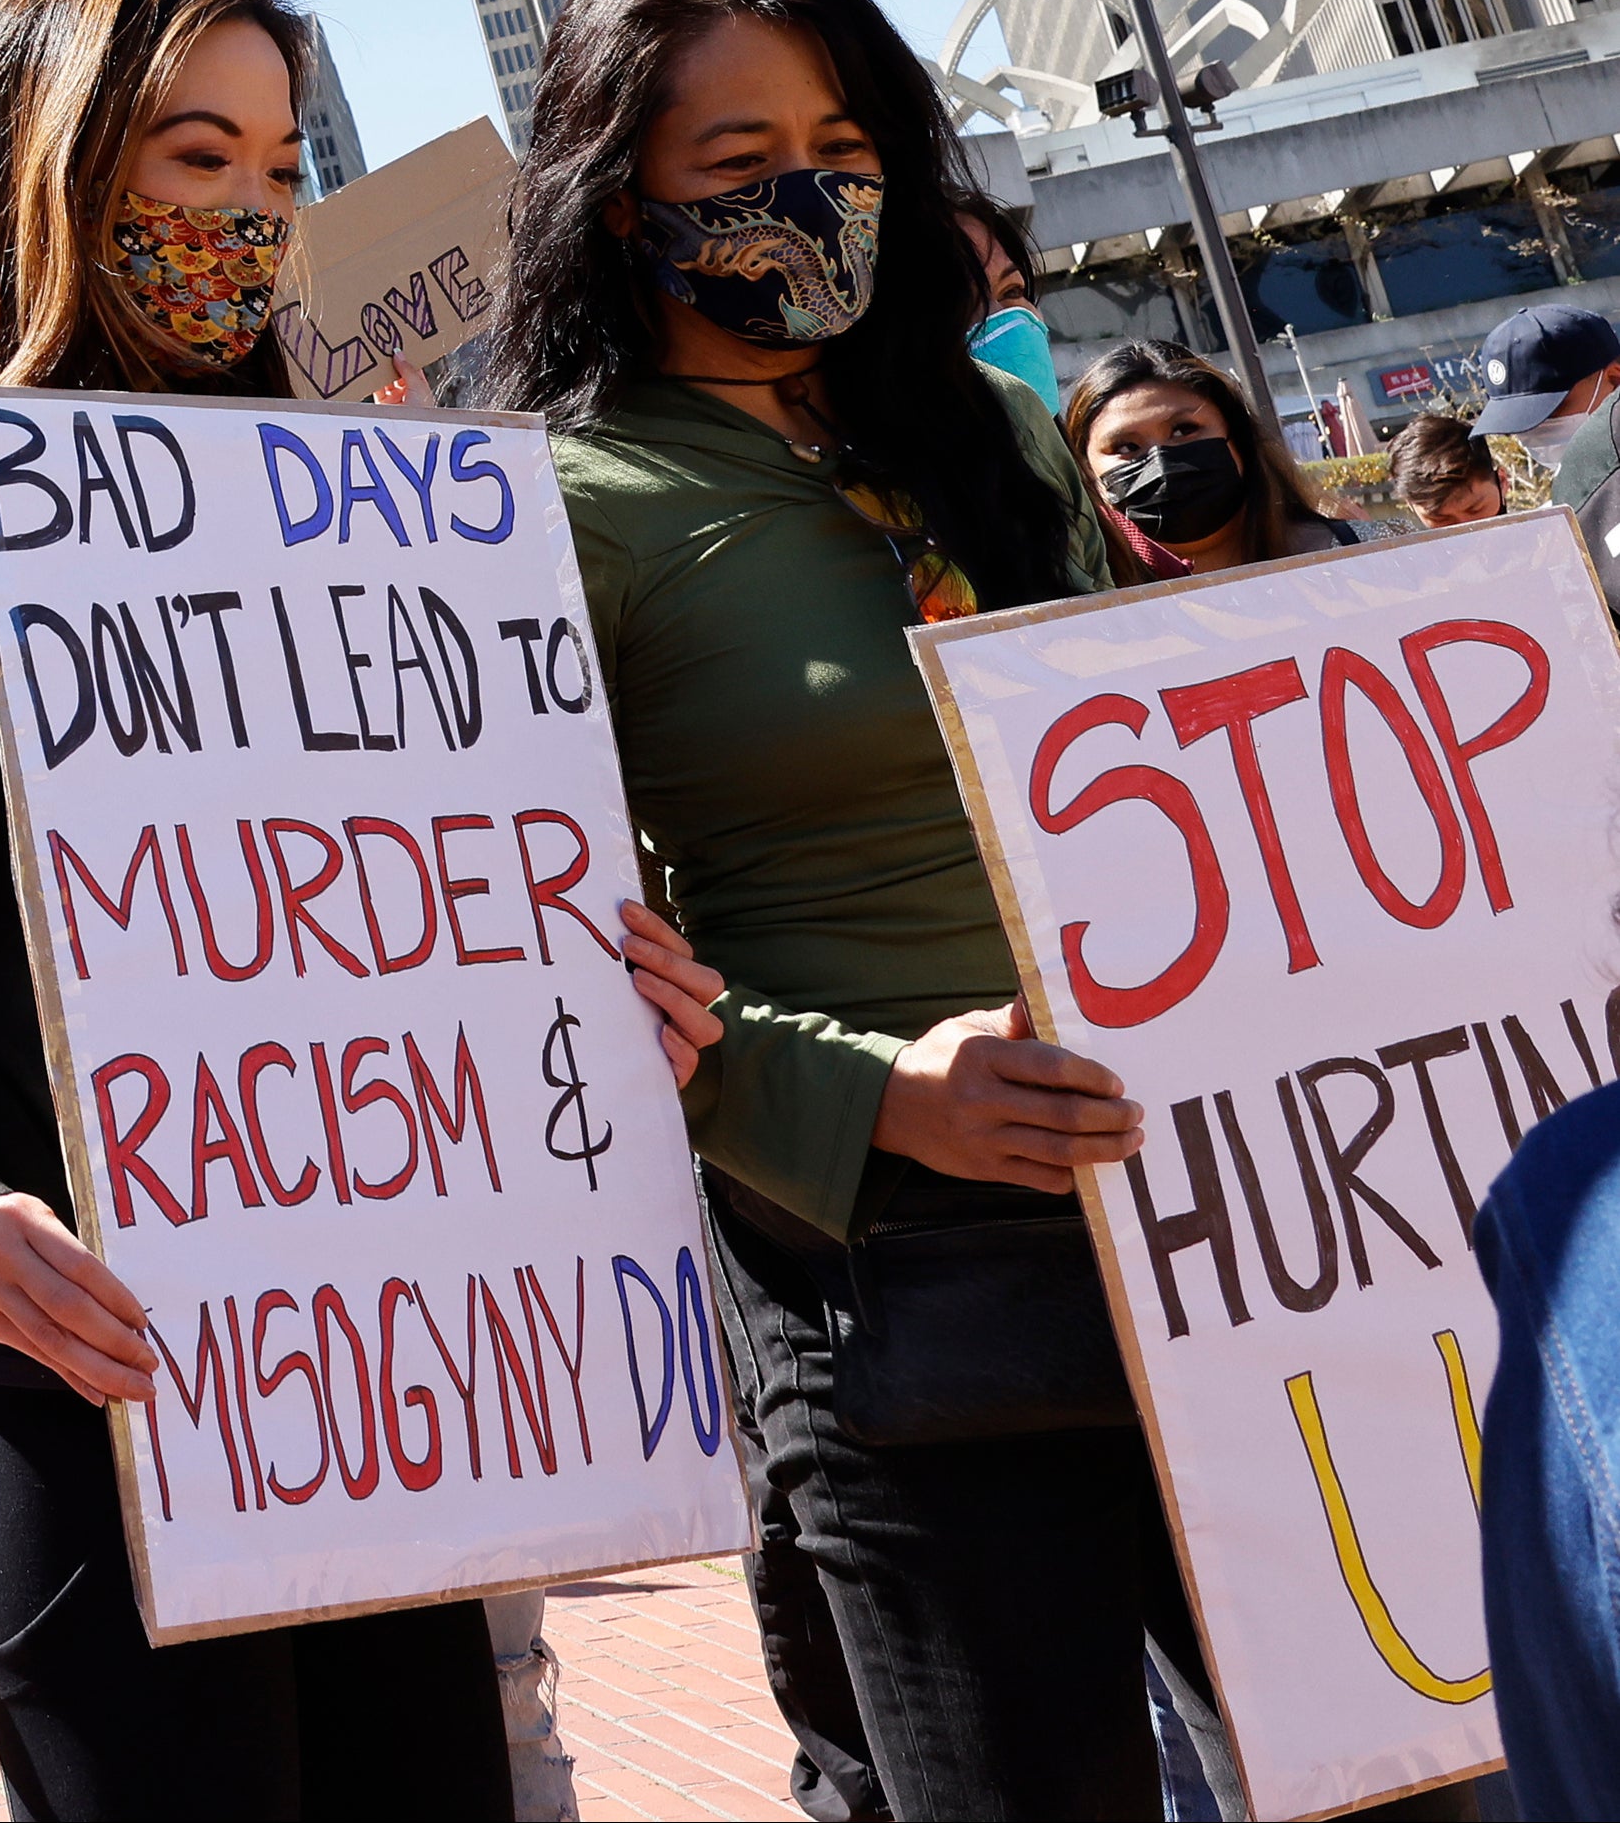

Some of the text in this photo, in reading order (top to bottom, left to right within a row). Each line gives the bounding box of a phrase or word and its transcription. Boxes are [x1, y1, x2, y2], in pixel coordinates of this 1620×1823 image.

[272, 245, 494, 400] LOVE
[1434, 355, 1481, 380] HA
[257, 422, 515, 547] DAYS
[9, 584, 592, 770] DON'T LEAD TO
[46, 808, 622, 982] MURDER
[1029, 619, 1551, 1029] STOP
[91, 996, 613, 1228] RACISM &
[1124, 982, 1620, 1342] HURTIN
[143, 1245, 720, 1522] MISOGYNY DO
[1284, 1328, 1493, 1705] U
